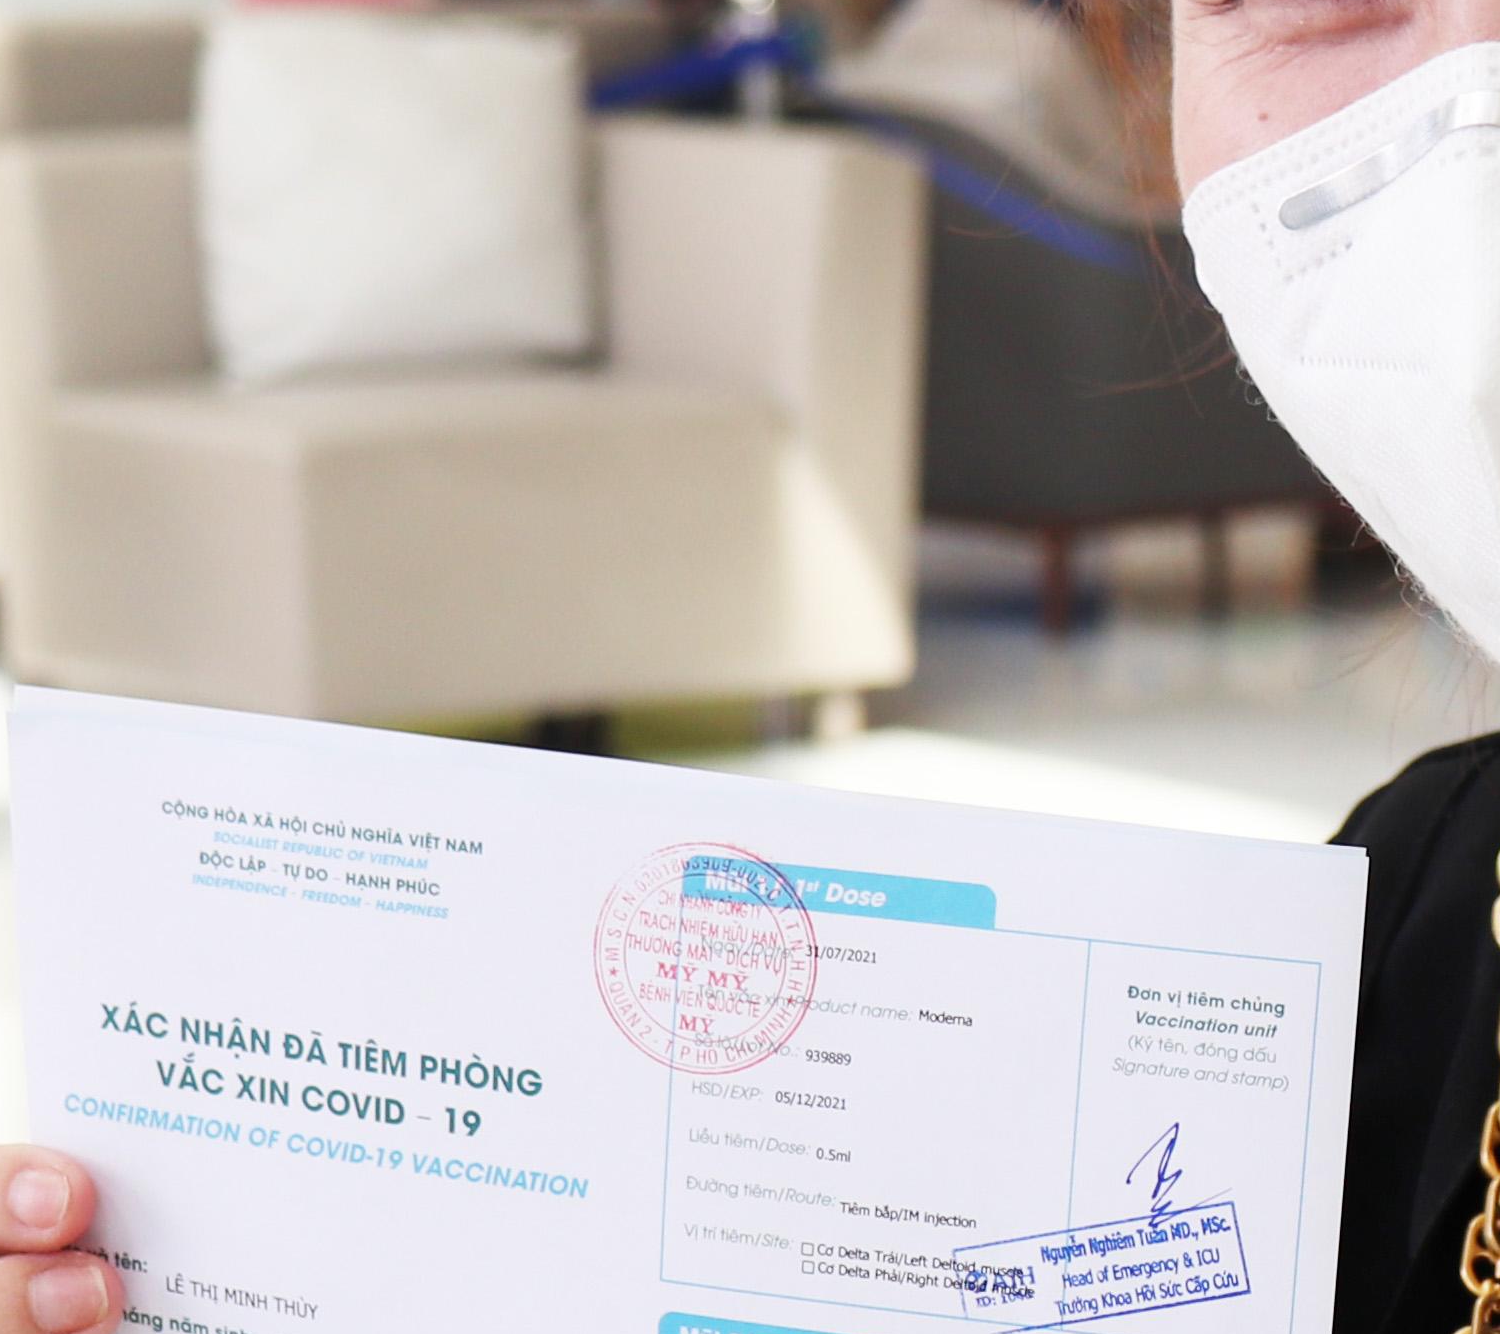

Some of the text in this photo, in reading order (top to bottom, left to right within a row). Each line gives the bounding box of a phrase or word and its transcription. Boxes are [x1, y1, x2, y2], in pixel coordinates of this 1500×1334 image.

[162, 800, 482, 854] CỘNG HÒA XÃ HỘI CHỦ NGHĨA VIỆT NAM
[213, 831, 428, 869] SOCIALIST REPUBLIC OF VIETNAM
[199, 850, 439, 896] ĐỘC LẬP TỰ DO HẠNH PHÚC
[193, 875, 449, 919] INDEPENDENCE FREEDOM HAPPINESS
[824, 882, 887, 908] Dose
[806, 944, 875, 963] 31/07/2021
[861, 1006, 972, 1026] name: Moderna
[1127, 985, 1285, 1018] Đơn vị tiêm chủng
[1137, 1011, 1277, 1037] Vaccination unit
[102, 1002, 542, 1096] XÁC NHẬN ĐÃ TIÊM PHÒNG
[806, 1050, 851, 1066] 939889
[1128, 1035, 1276, 1063] (Ký tên, đóng dấu
[1112, 1057, 1289, 1092] Signature and stamp)
[157, 1053, 481, 1136] VẮC XIN COVID 19
[692, 1081, 846, 1110] HSD/EXP: 05/12/2021
[65, 1094, 588, 1198] CONFIRMATION OF COVID-19 VACCINATION
[724, 1132, 811, 1155] tiêm/Dose:
[816, 1147, 851, 1162] 0.5ml
[686, 1175, 836, 1207] Đường tiêm/Route:
[840, 1202, 976, 1228] Tiêm bắp/IM injection
[721, 1228, 794, 1250] tiêm/Site:
[817, 1244, 834, 1257] Cơ
[839, 1246, 869, 1260] Delta
[112, 1252, 147, 1273] tên:
[818, 1262, 938, 1288] Cơ Delta Phải/Right
[1062, 1248, 1220, 1289] Head of Emergency & ICU
[166, 1273, 318, 1319] LÊ THỊ MINH THÙY
[1101, 1292, 1132, 1308] Khoa
[123, 1305, 163, 1332] áng
